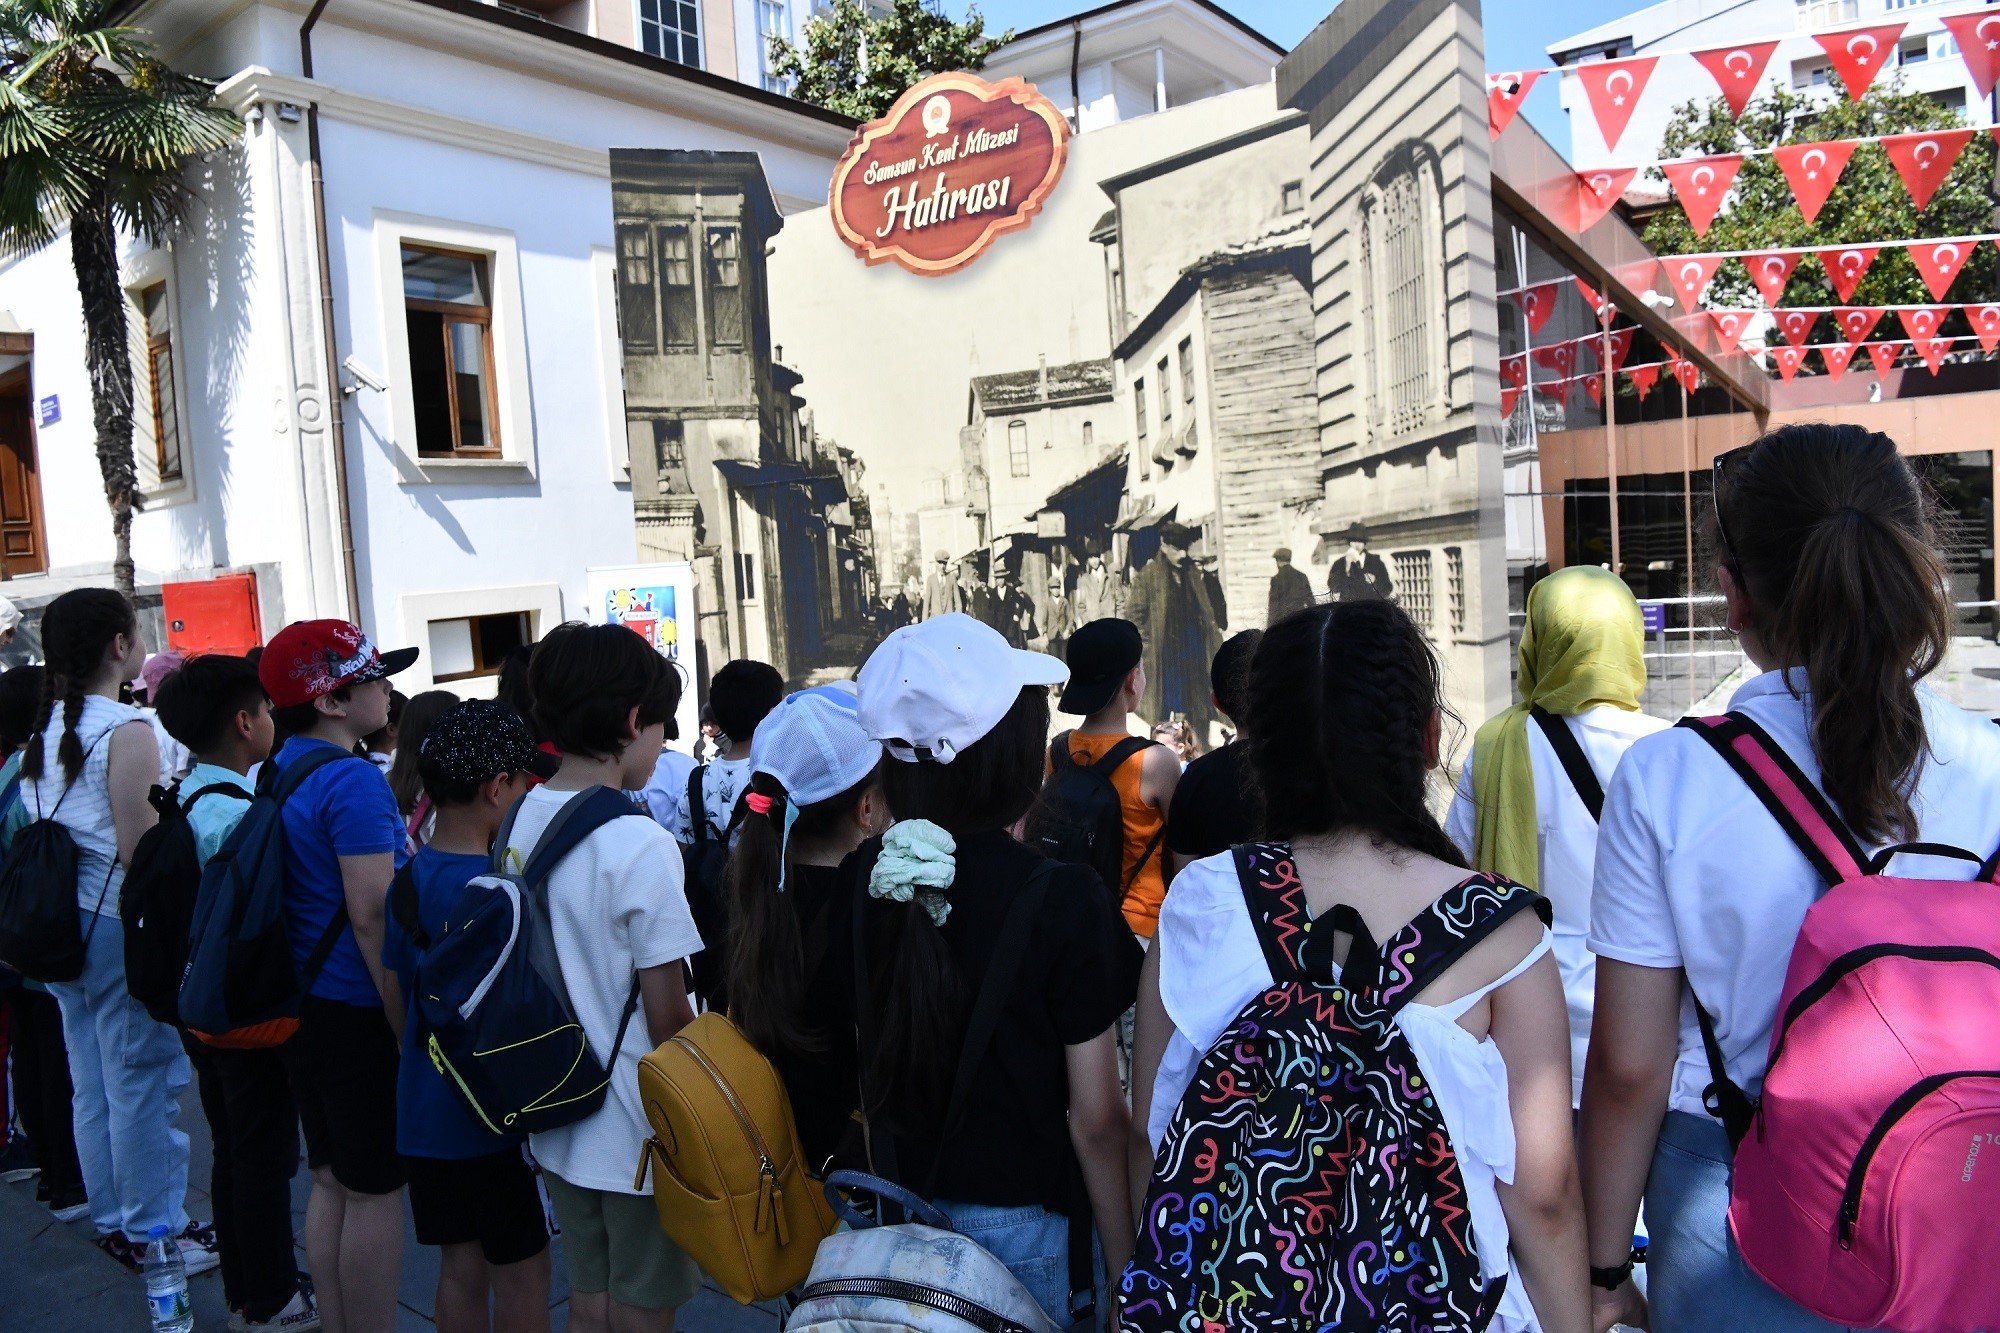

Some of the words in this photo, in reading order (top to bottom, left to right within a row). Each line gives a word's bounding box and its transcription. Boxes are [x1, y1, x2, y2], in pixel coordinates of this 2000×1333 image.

[863, 157, 916, 185] Samsun
[919, 135, 960, 170] Kent
[960, 123, 1019, 158] Müzesi
[876, 171, 1010, 238] Hatırası
